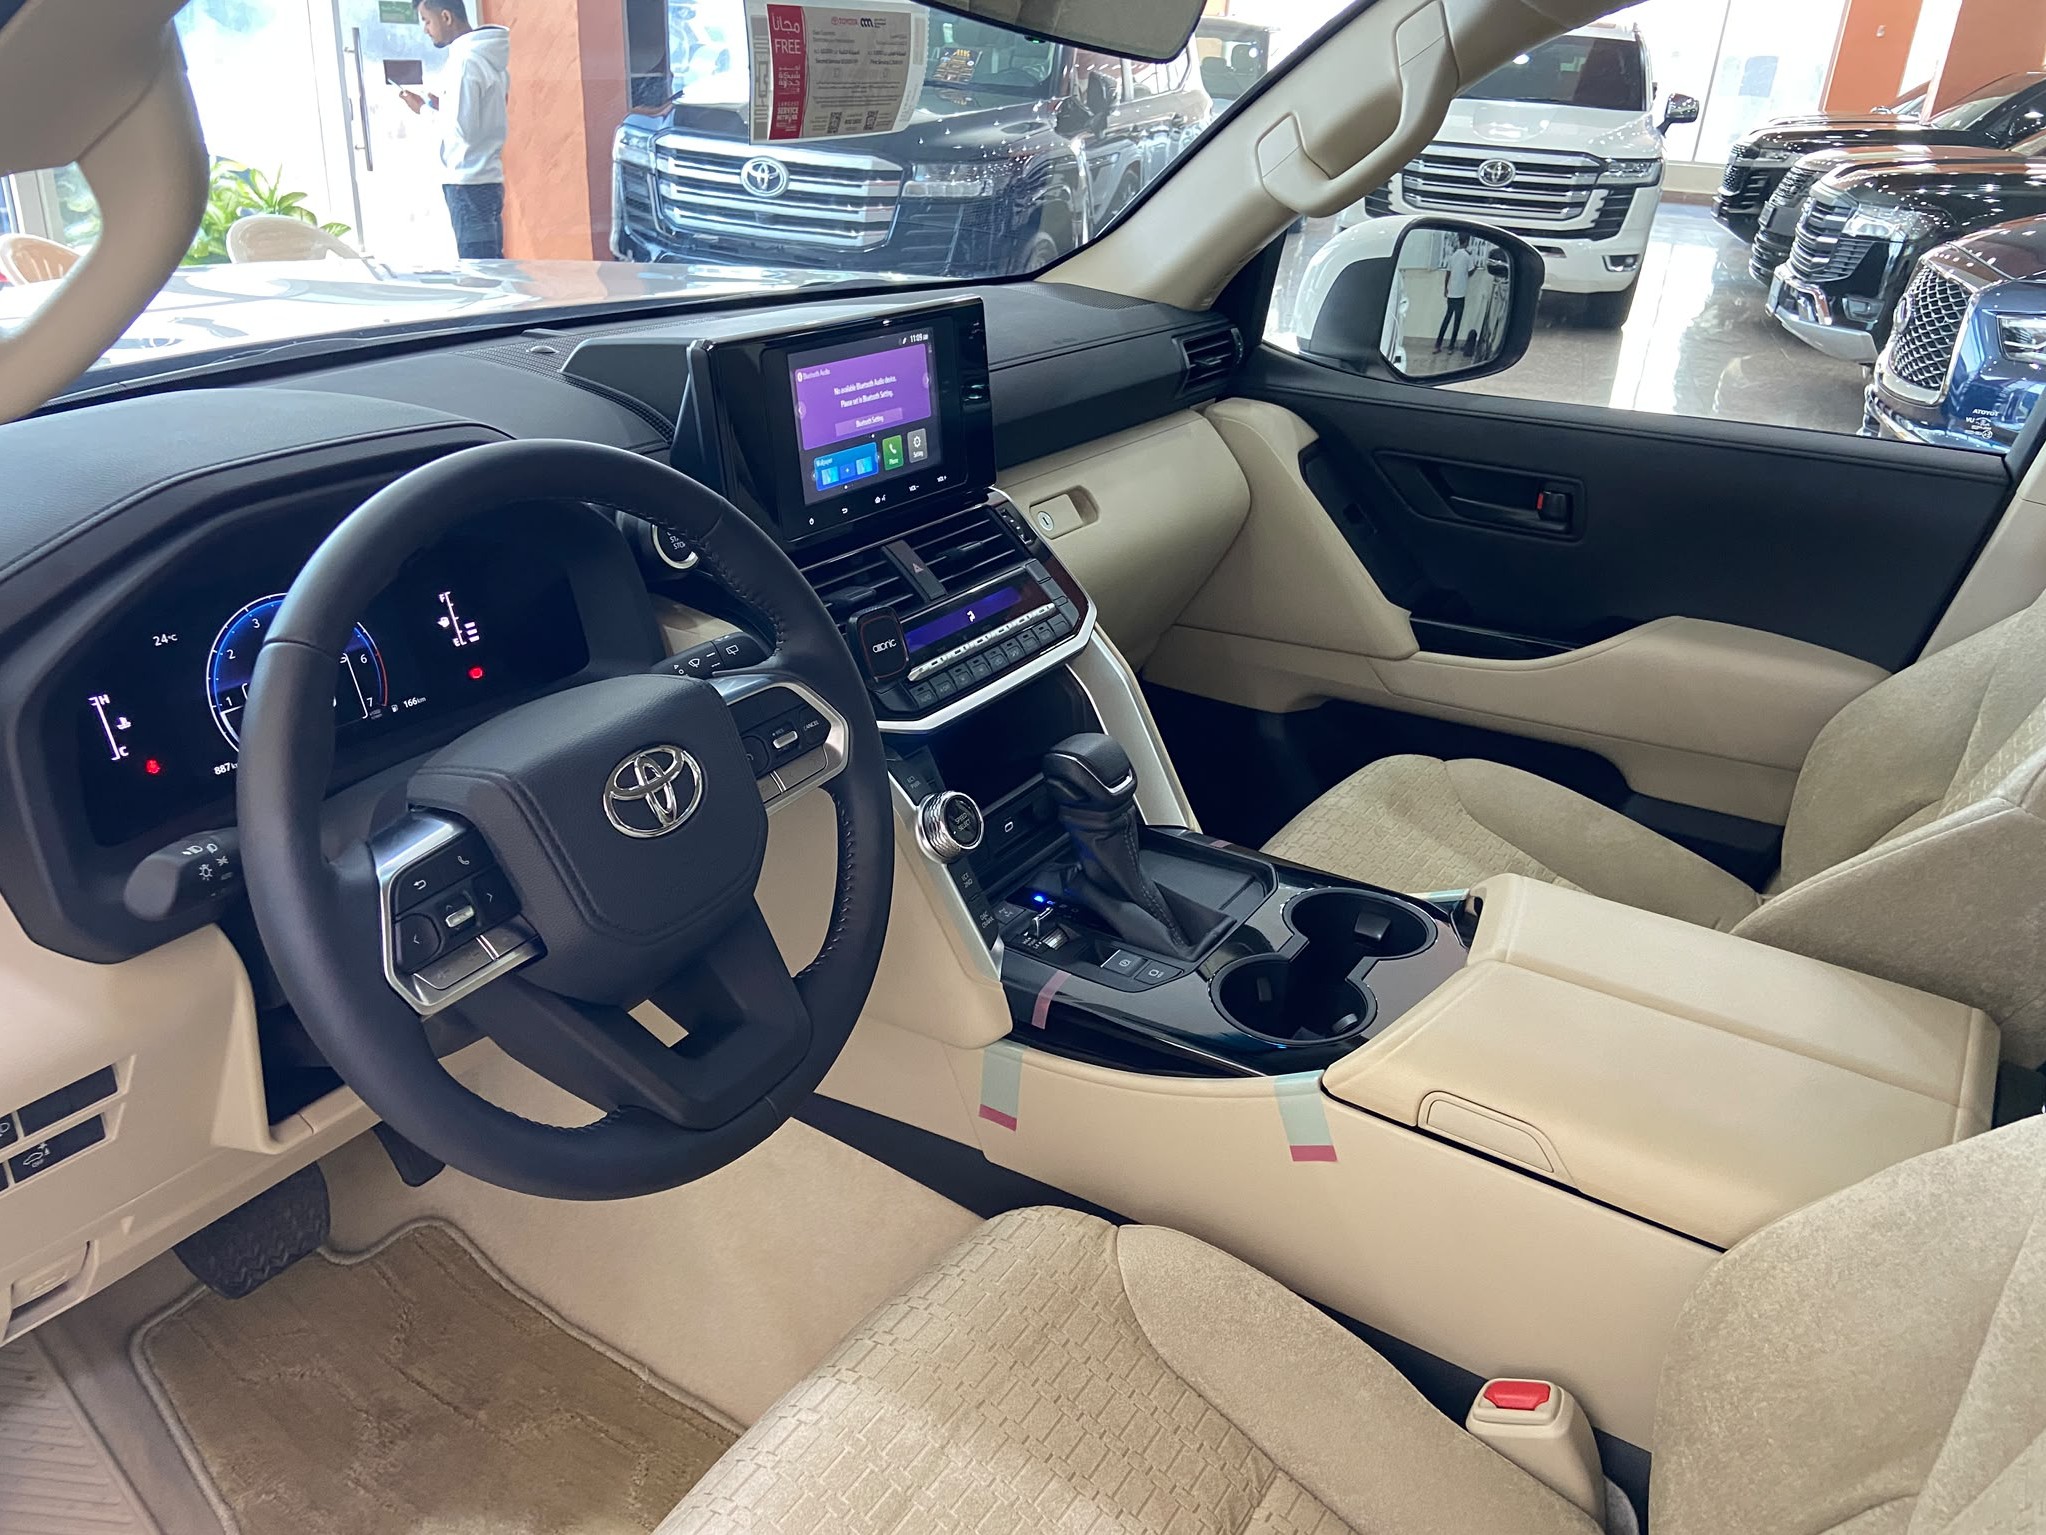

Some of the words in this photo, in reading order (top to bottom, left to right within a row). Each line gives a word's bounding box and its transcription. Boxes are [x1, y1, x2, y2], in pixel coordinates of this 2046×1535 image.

[774, 38, 801, 54] FREE
[251, 618, 260, 628] 3
[452, 638, 460, 647] E
[227, 649, 236, 660] 2
[360, 654, 368, 664] 6
[98, 694, 110, 705] H
[225, 697, 233, 707] 1
[366, 697, 373, 707] 7
[803, 720, 819, 731] CANCEL
[118, 746, 129, 757] C
[954, 812, 968, 824] SPEED
[957, 818, 971, 831] SELECT
